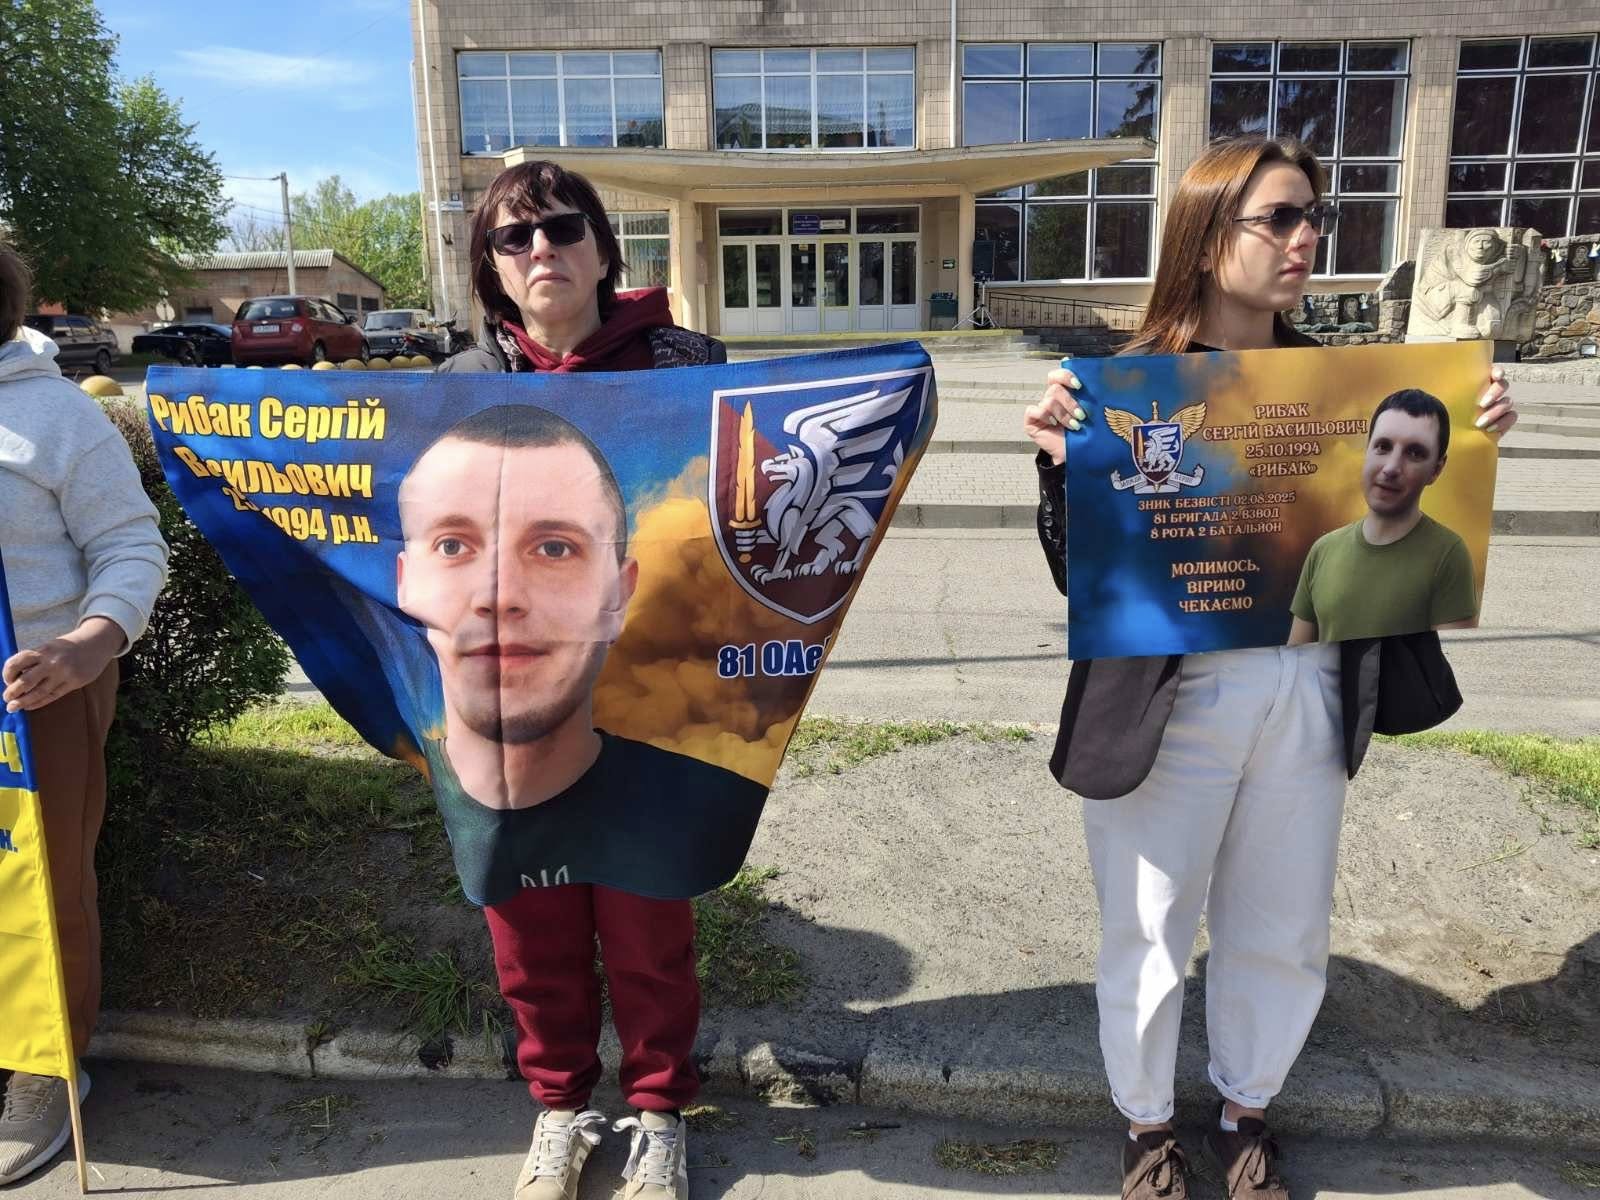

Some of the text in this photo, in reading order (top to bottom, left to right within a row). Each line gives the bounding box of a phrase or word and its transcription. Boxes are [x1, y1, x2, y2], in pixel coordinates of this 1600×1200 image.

[149, 394, 387, 443] Рибак Сергій
[1255, 403, 1309, 419] РИБАК
[1202, 420, 1367, 441] СЕРГІЙ ВАСИЛЬОВИЧ
[1246, 442, 1321, 459] 25.10.1994
[1249, 460, 1318, 477] «РИБАК»
[1138, 491, 1296, 511] ЗНИК БЕЗВІСТІ 02.08.2025
[1153, 513, 1167, 524] 81
[1170, 511, 1228, 523] БРИГАДА
[1242, 508, 1280, 519] ВЗВОД
[330, 514, 379, 545] р.н.
[1150, 527, 1159, 539] 8
[1162, 527, 1195, 538] РОТА
[1198, 526, 1206, 537] 2
[1186, 578, 1245, 593] ВІРИМО
[1179, 597, 1253, 612] ЧЕКАЄМО
[718, 636, 832, 678] 81 ОАе
